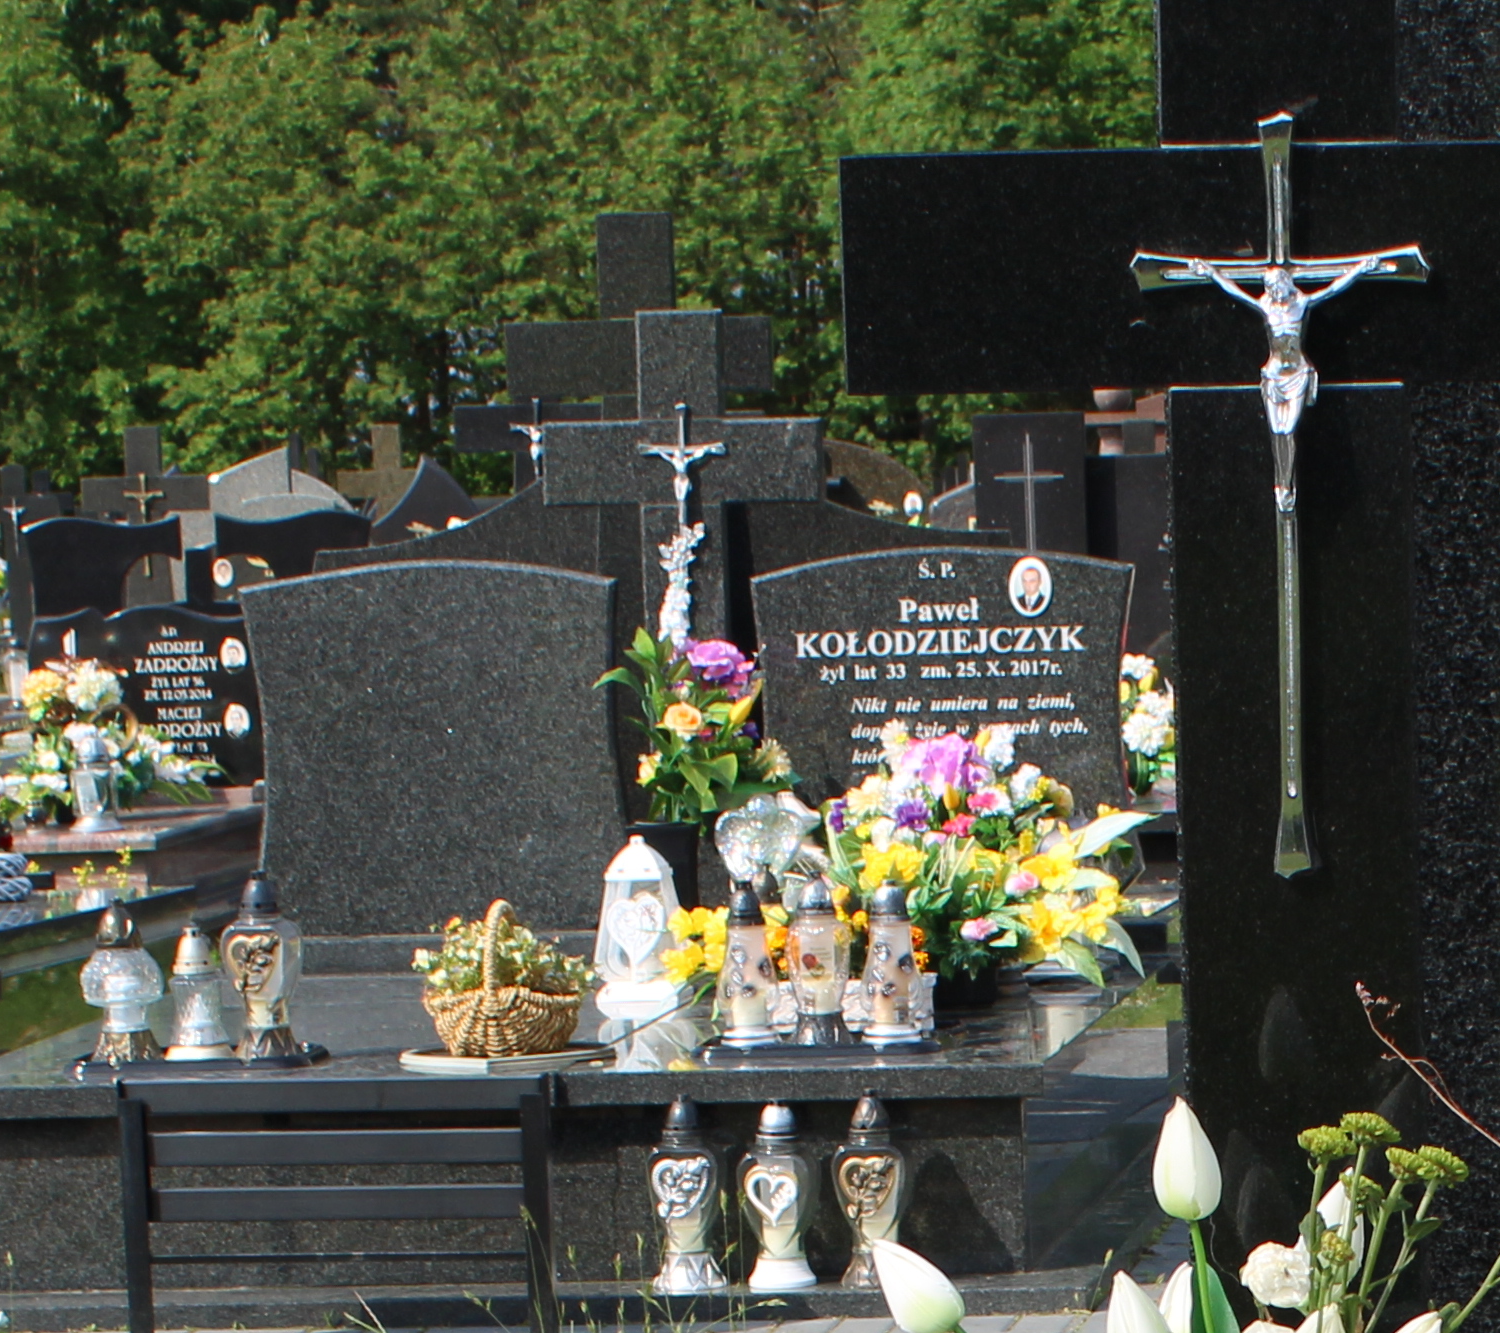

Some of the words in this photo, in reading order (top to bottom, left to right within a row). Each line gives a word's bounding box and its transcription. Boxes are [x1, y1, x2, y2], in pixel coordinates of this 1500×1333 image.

[899, 597, 980, 623] Paweł
[795, 625, 1087, 658] KOŁODZIEJCZYK
[134, 654, 218, 674] ZADROŻNY
[820, 664, 846, 685] żył
[854, 663, 877, 681] lat
[886, 663, 906, 680] 33
[920, 666, 952, 679] zm.
[851, 696, 887, 714] Nikt
[895, 696, 922, 713] nie
[930, 695, 989, 712] umiera
[997, 697, 1018, 711] na
